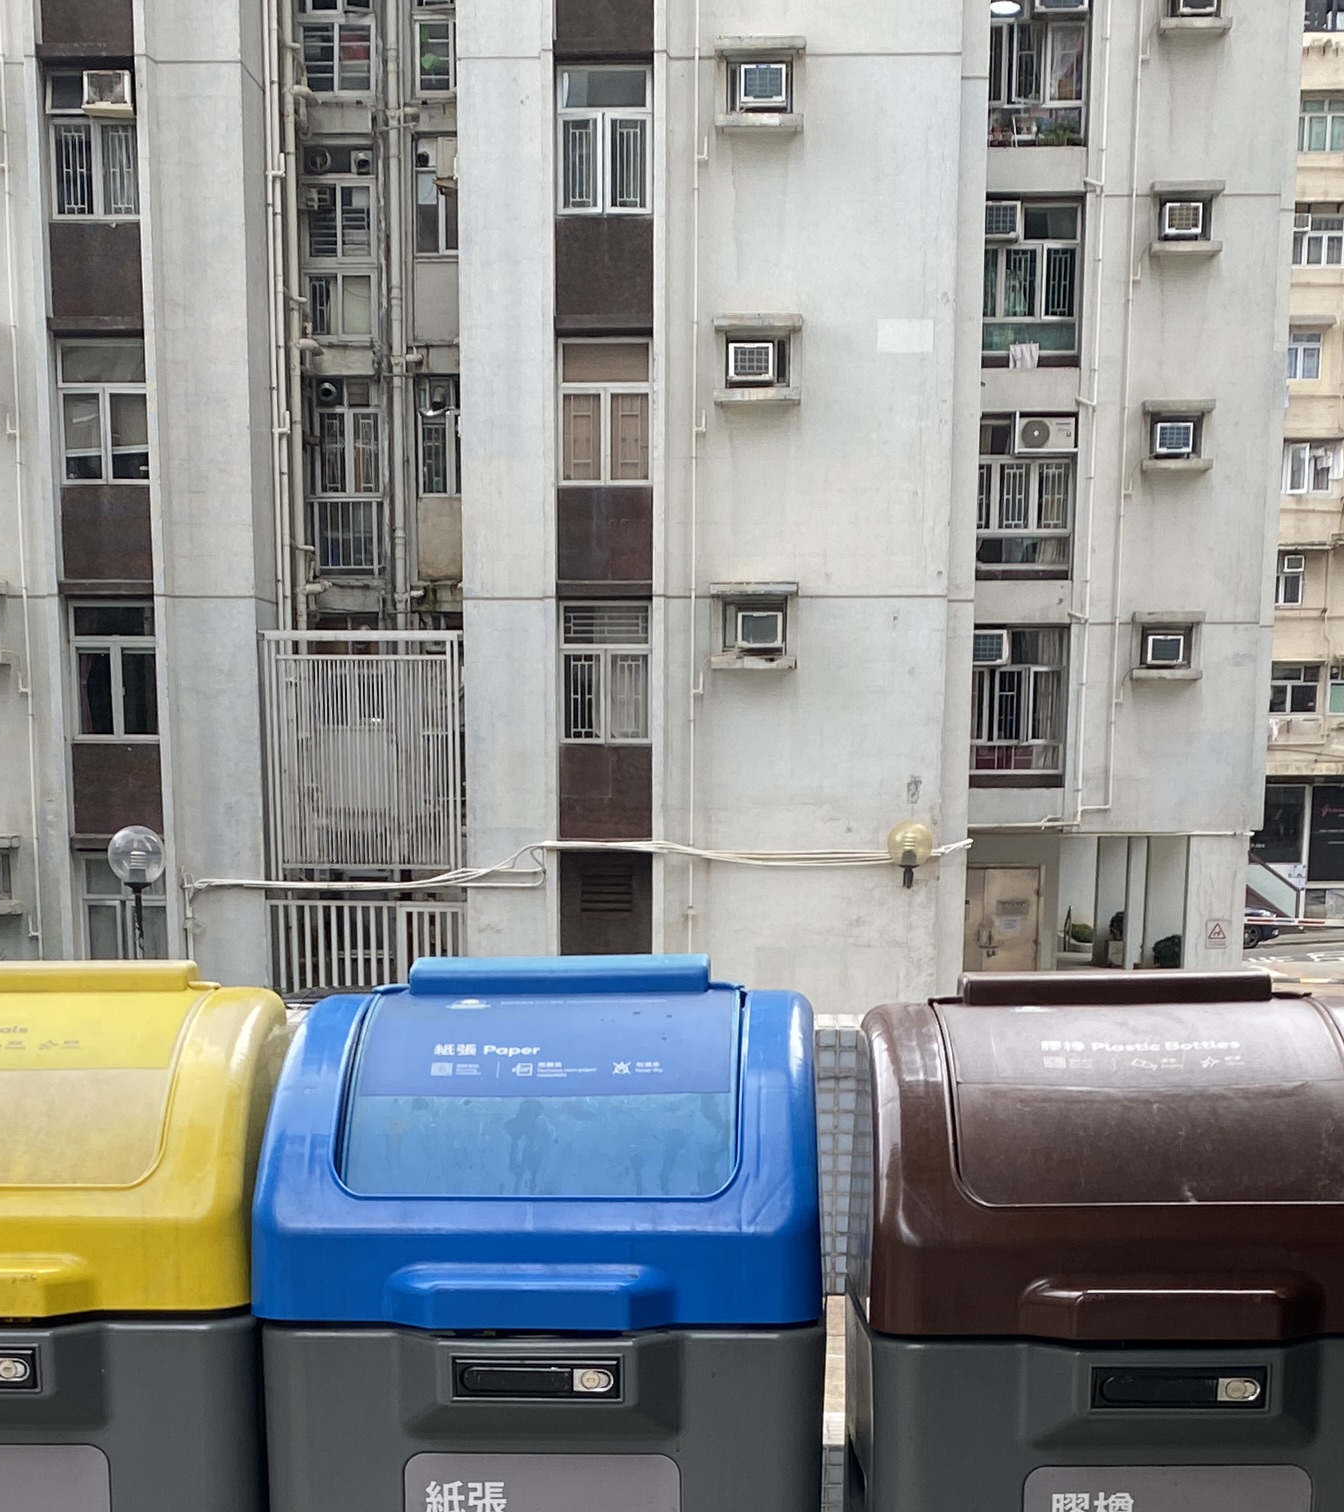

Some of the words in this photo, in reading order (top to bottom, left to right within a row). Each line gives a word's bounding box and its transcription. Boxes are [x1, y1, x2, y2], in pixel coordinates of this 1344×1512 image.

[483, 1044, 541, 1058] Paper
[1092, 1041, 1160, 1052] Plastic
[1164, 1040, 1240, 1051] Bottles
